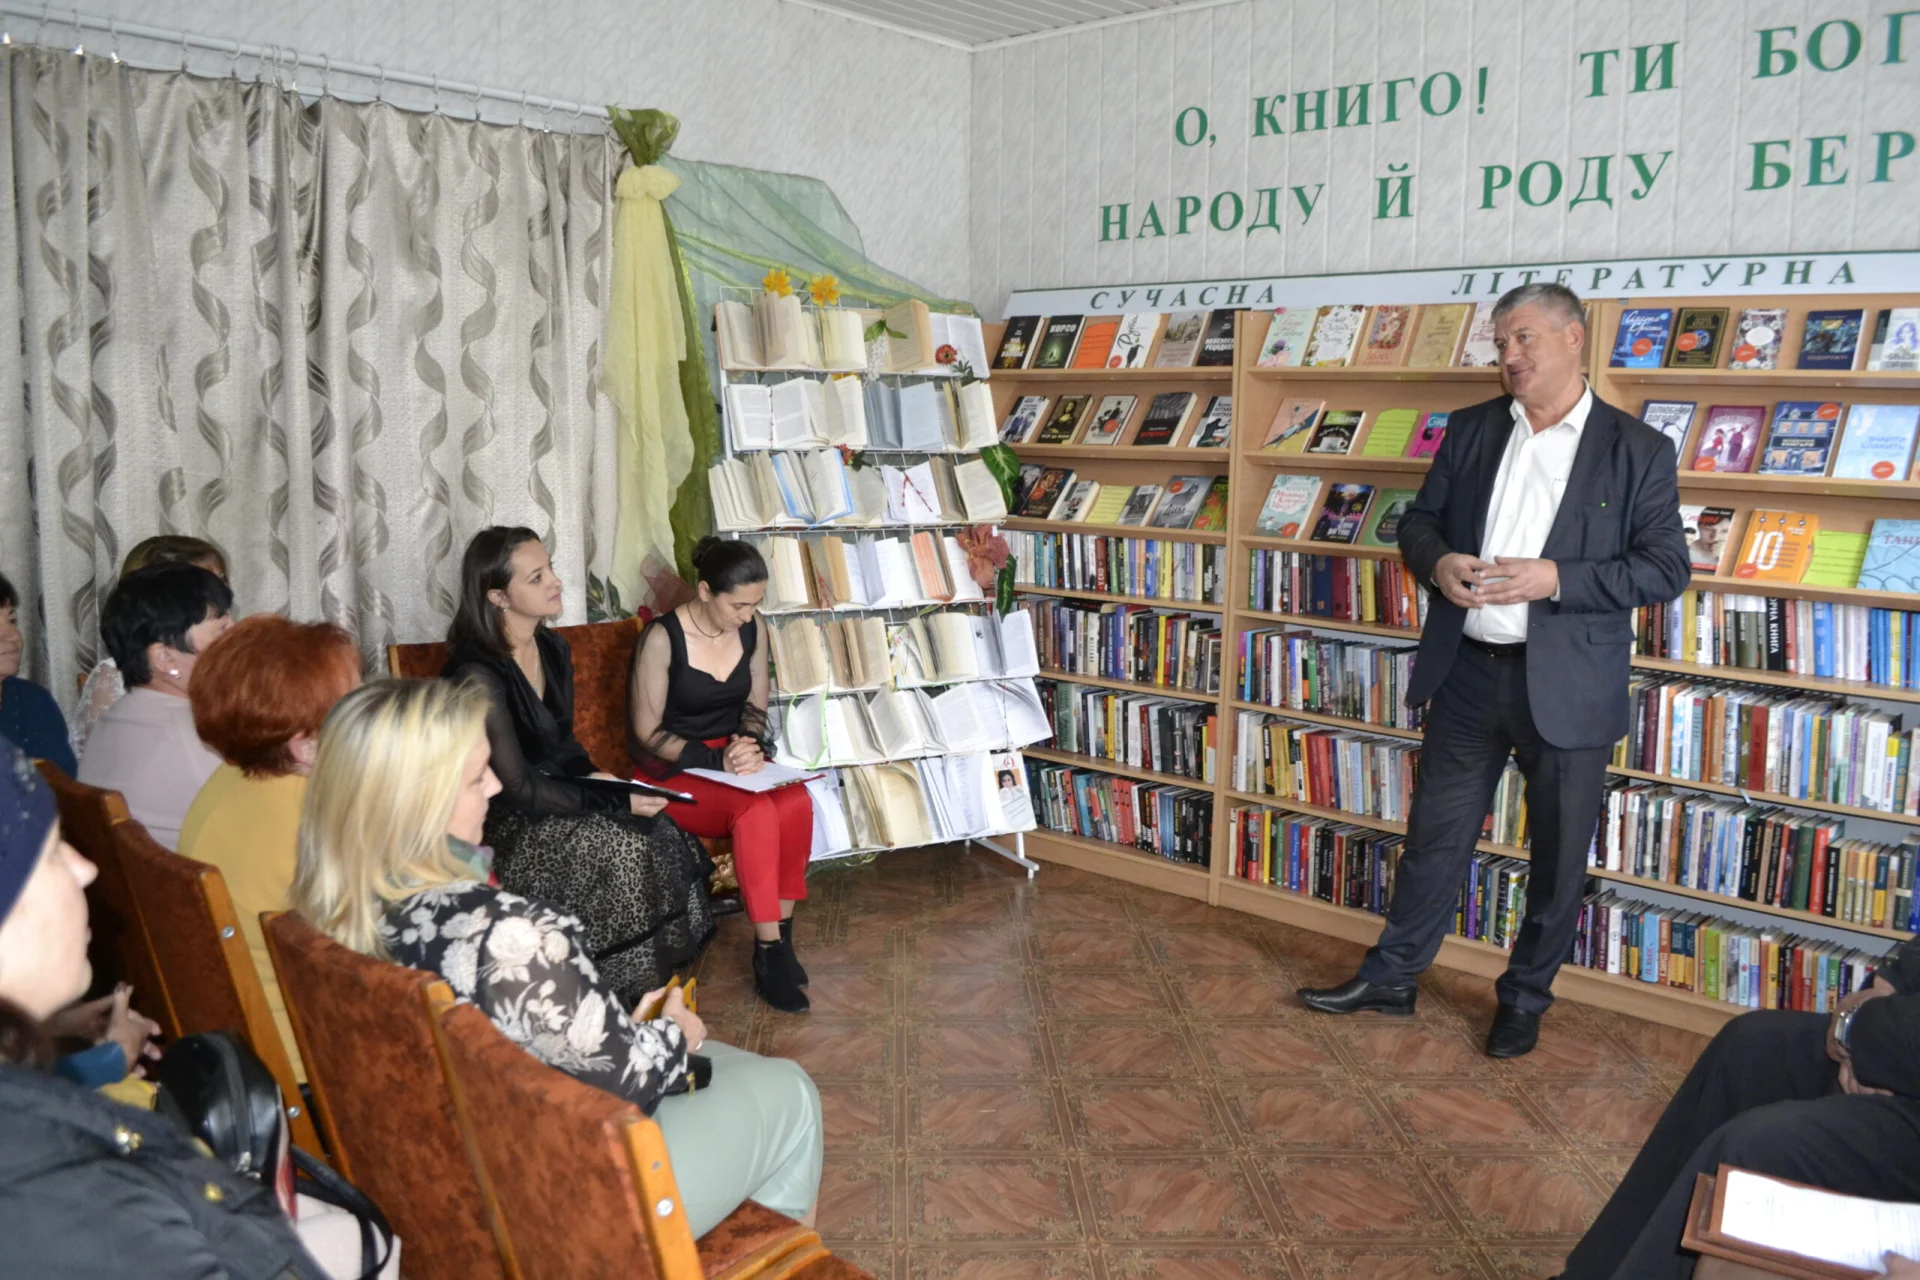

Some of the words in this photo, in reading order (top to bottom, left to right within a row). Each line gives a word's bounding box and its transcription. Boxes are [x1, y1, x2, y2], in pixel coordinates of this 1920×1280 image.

[1175, 106, 1216, 148] О,
[1252, 66, 1488, 138] КНИГО!
[1579, 41, 1680, 98] ТИ
[1100, 183, 1326, 242] НАРОДУ
[1373, 163, 1416, 220] Й
[1478, 150, 1674, 213] РОДУ
[1744, 131, 1915, 192] БЕР
[1090, 283, 1275, 309] СУЧАСНА
[1747, 530, 1784, 570] 10
[1769, 623, 1779, 654] КНИГА
